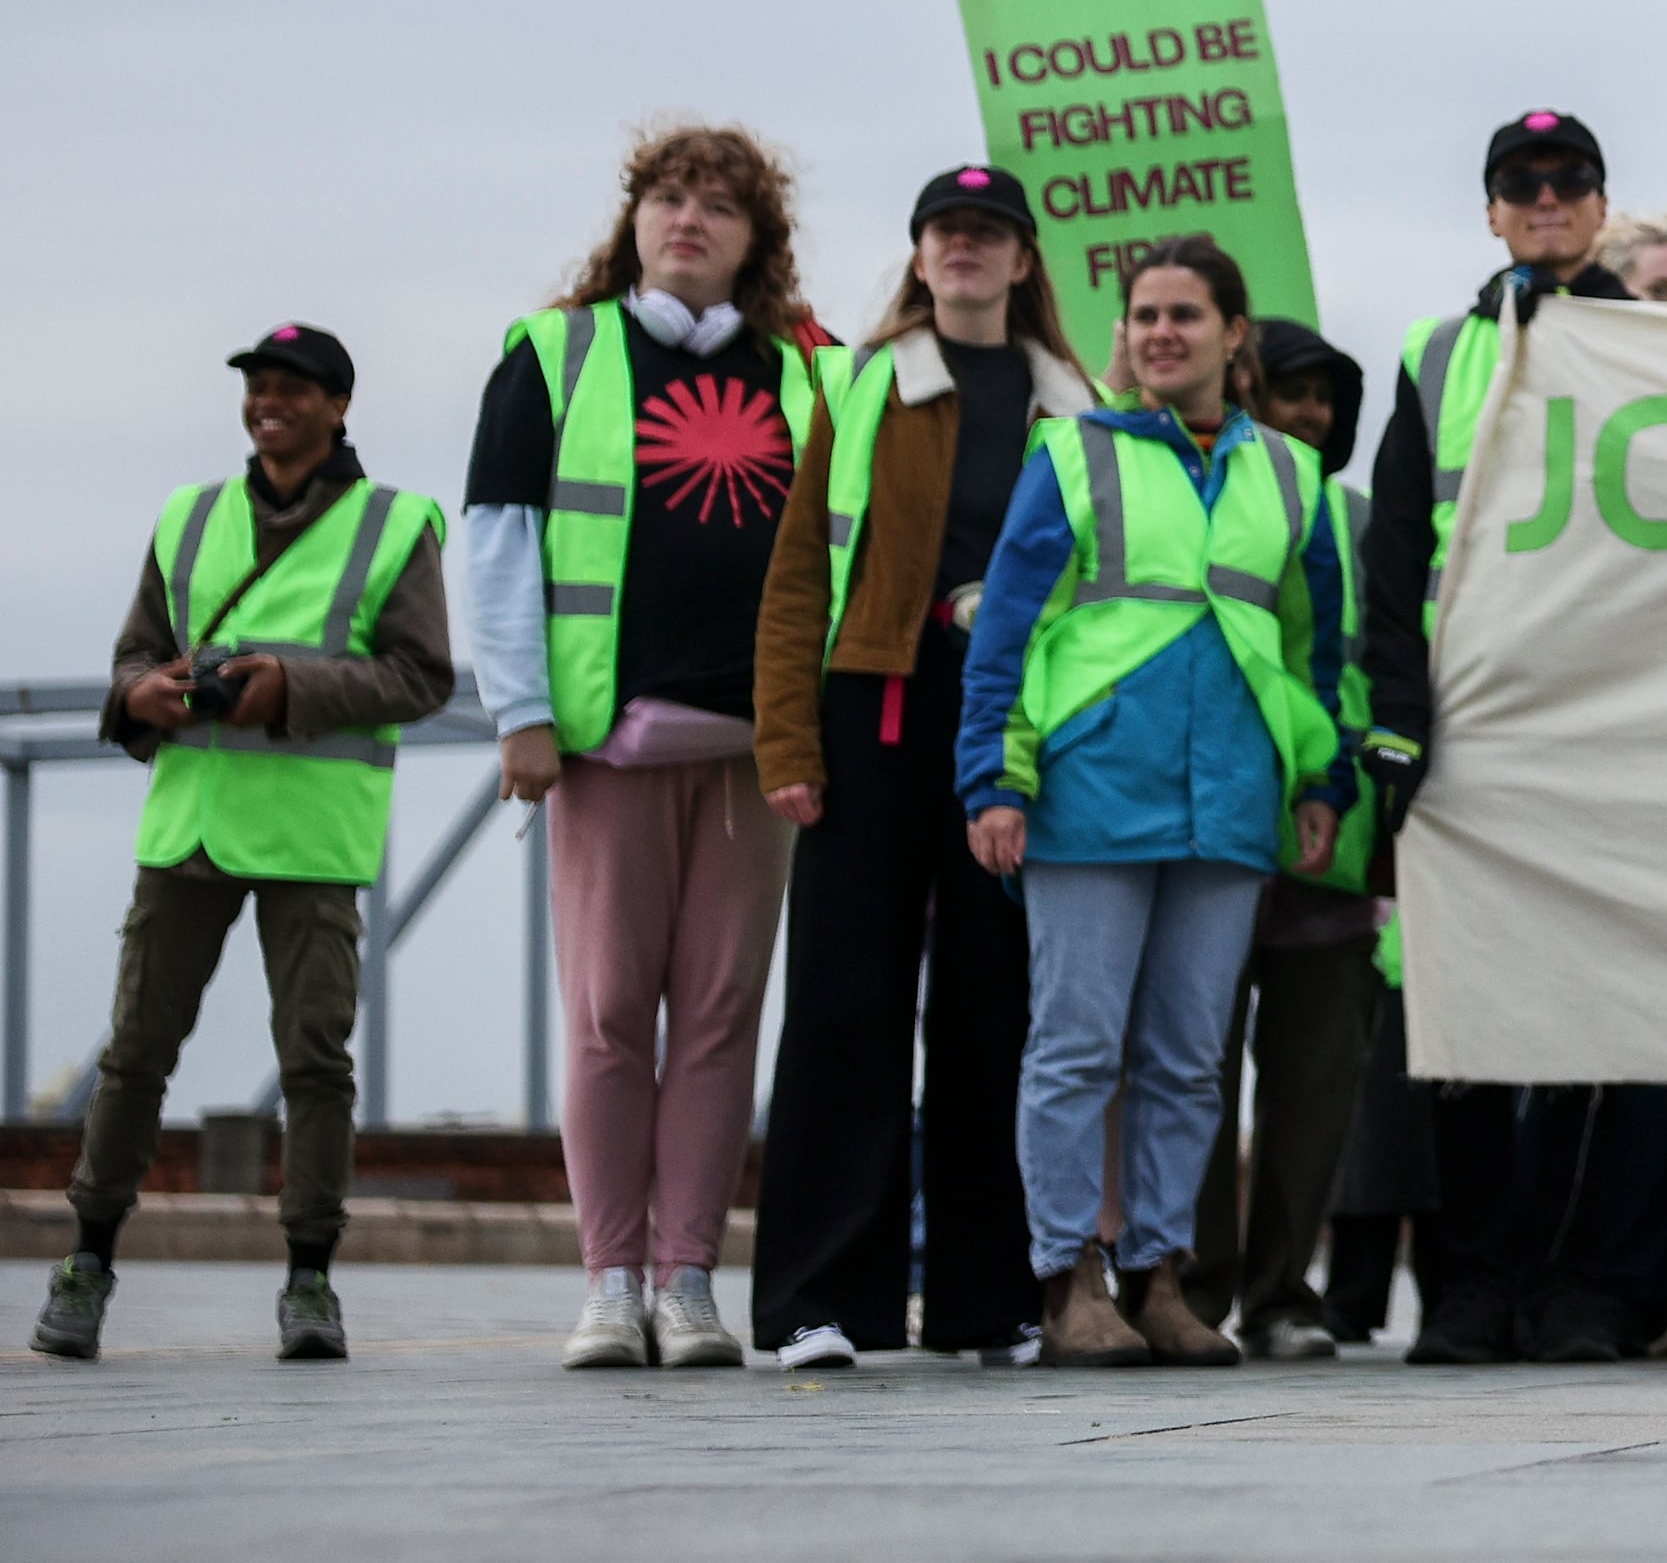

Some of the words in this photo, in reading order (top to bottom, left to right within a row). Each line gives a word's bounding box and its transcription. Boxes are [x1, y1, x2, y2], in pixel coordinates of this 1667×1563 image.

[983, 48, 1002, 89] I
[1008, 27, 1185, 86] COULD
[1193, 17, 1260, 64] BE
[1018, 86, 1254, 151] FIGHTING
[1042, 156, 1254, 221] CLIMATE
